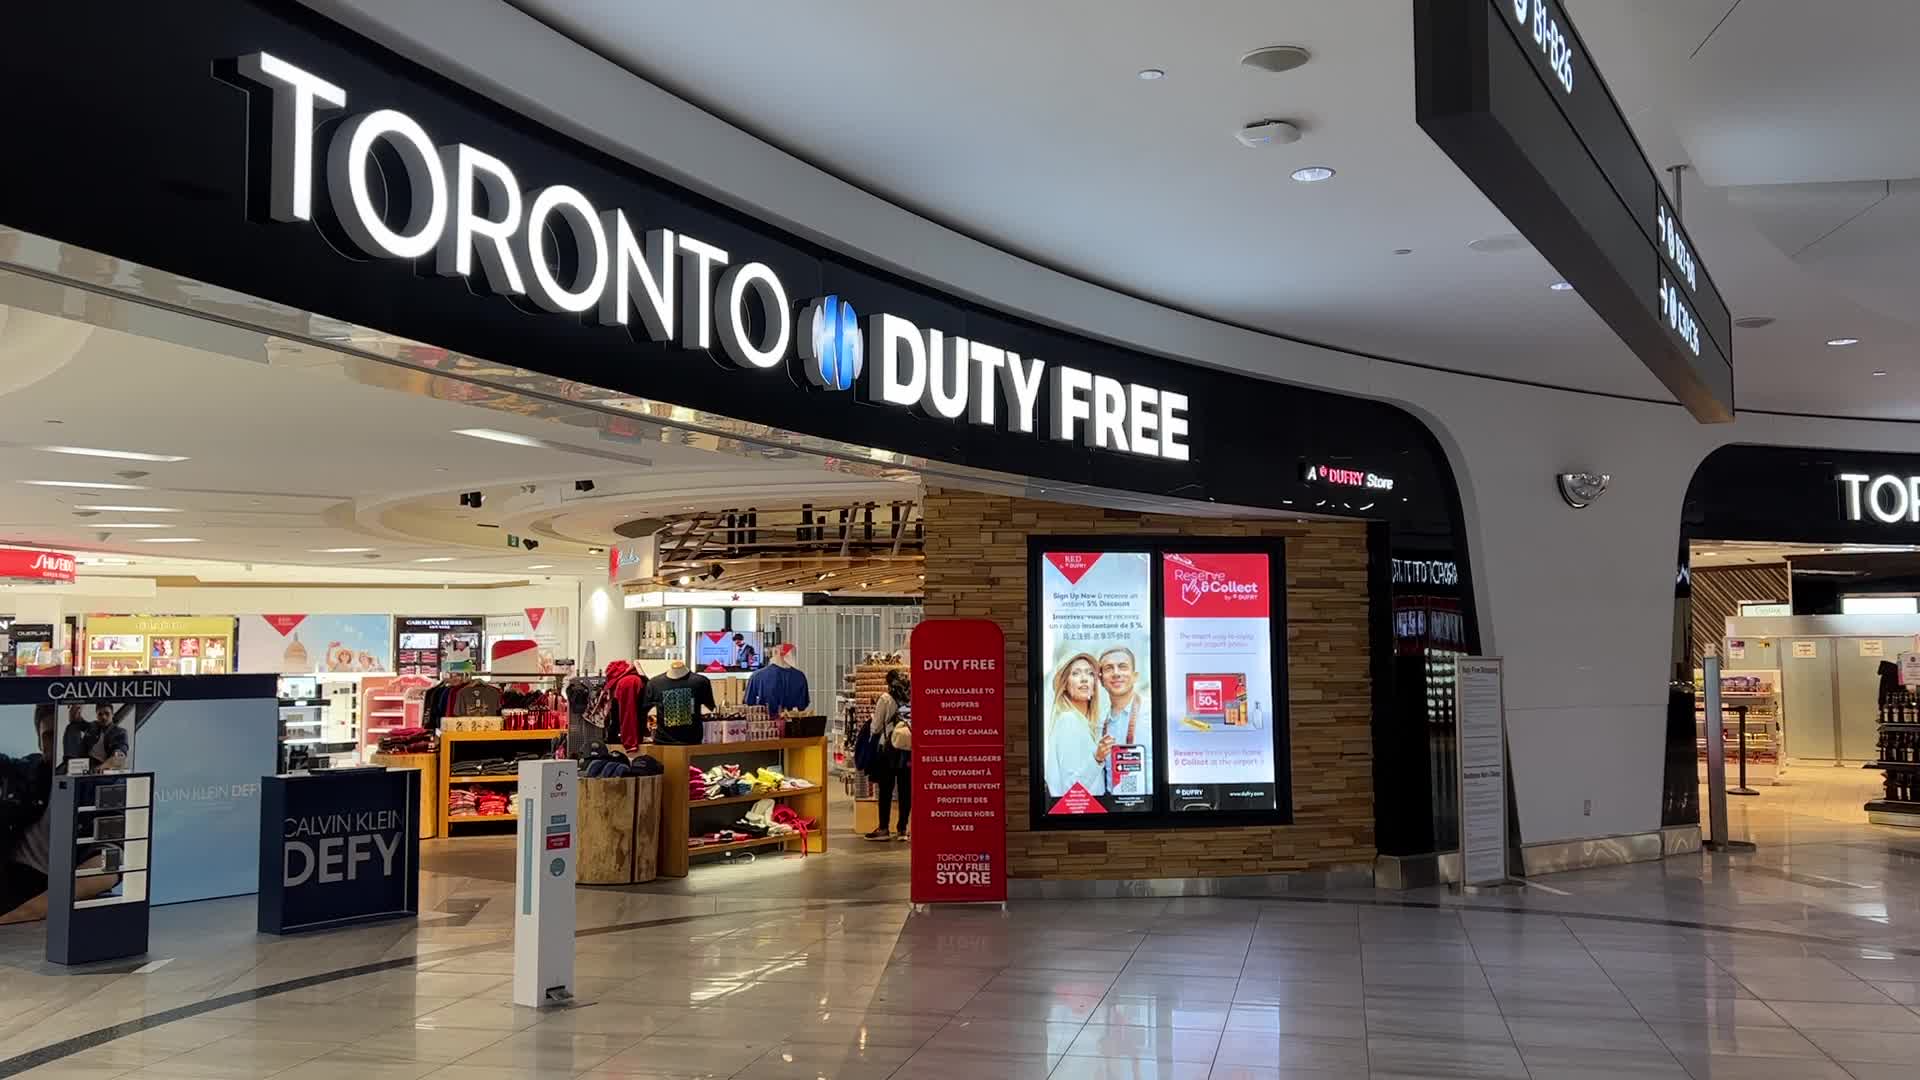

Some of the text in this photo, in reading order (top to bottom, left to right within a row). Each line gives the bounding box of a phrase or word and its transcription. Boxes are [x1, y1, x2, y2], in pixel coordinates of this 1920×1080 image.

[1533, 0, 1573, 94] B1-B26
[260, 51, 1189, 461] TORONTO DUTY FREE
[1307, 466, 1394, 490] A DUFRY Store
[1174, 568, 1226, 581] Reserve
[1201, 581, 1258, 593] & Collect
[923, 659, 996, 671] DUTY FREE
[47, 680, 171, 700] CALVIN KLEIN
[925, 687, 944, 695] ONLY
[941, 701, 980, 709] SHOPPERS
[986, 767, 992, 775] À
[283, 809, 403, 838] CALVIN KLEIN
[283, 832, 403, 888] DEFY
[936, 853, 979, 862] TORONTO
[936, 863, 991, 871] DUTY FREE
[936, 872, 991, 885] STORE
